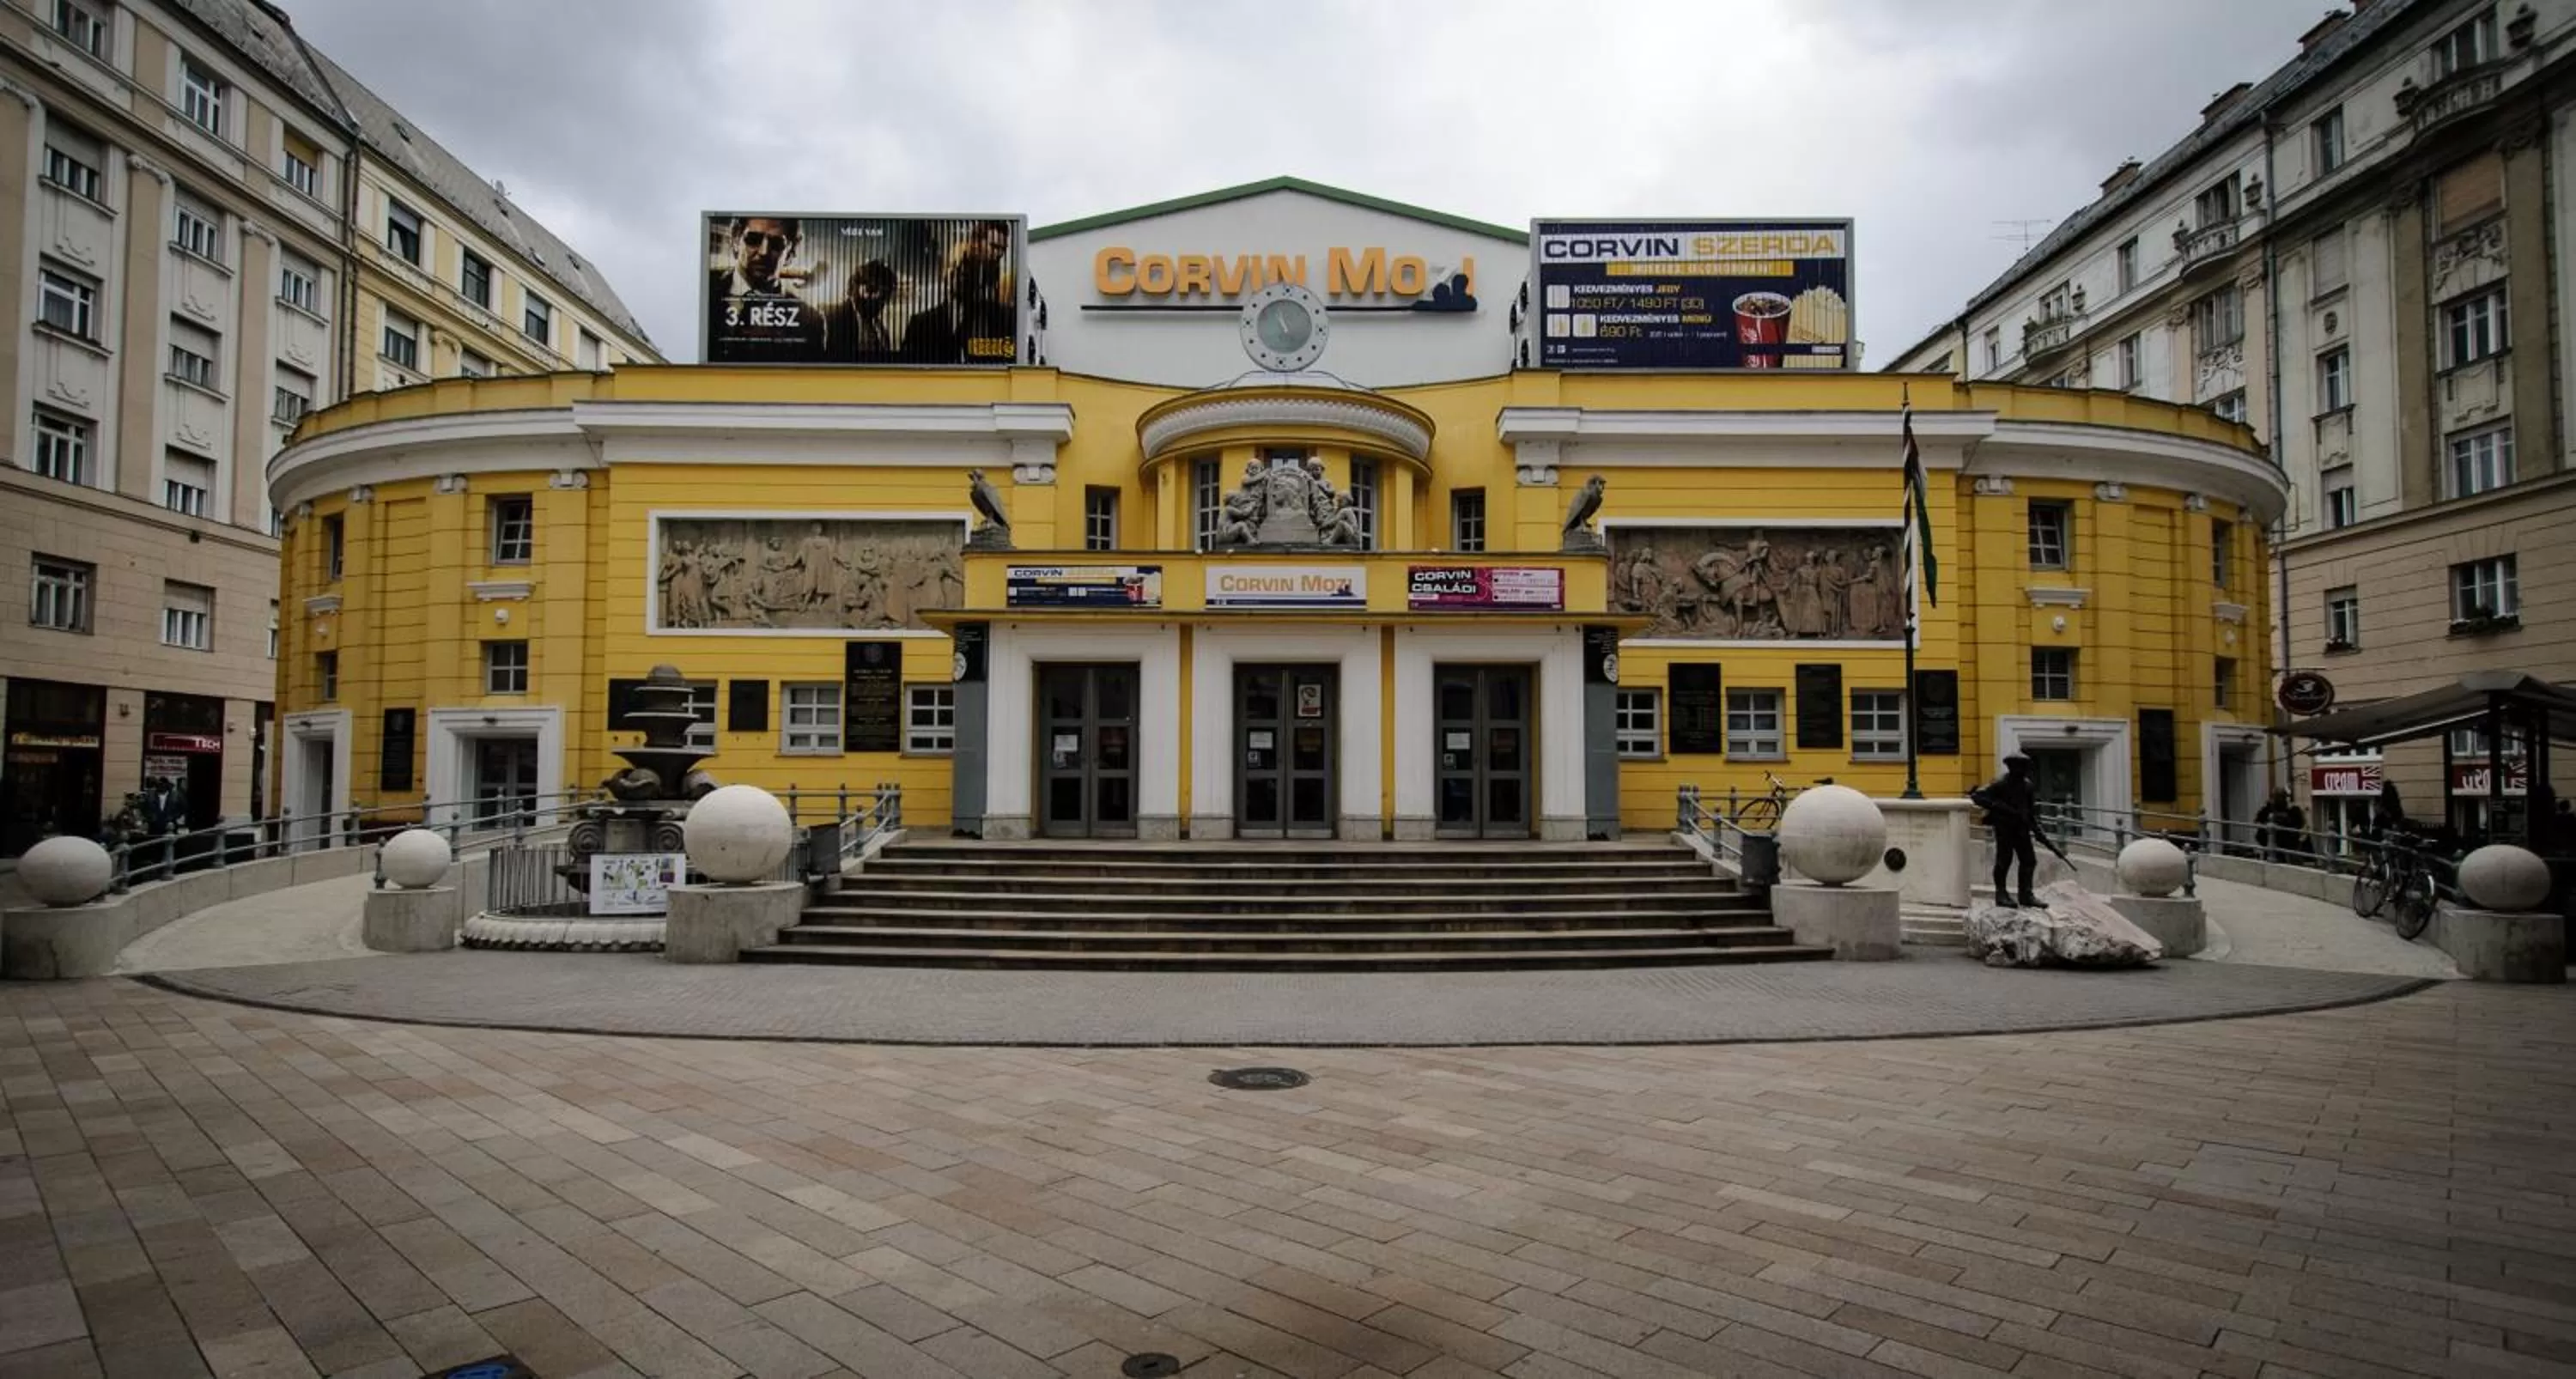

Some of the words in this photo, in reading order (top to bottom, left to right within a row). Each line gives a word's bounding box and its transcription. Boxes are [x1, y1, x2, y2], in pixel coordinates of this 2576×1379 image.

[1544, 237, 1679, 258] CORVIN
[1692, 234, 1836, 256] SZERDA
[725, 306, 745, 326] 3.
[750, 301, 800, 326] RÉSZ
[1014, 569, 1063, 578] CORVIN
[1414, 569, 1471, 581] CORVIN
[1219, 574, 1294, 592] CORVIN
[1411, 582, 1477, 594] CSALÁDI
